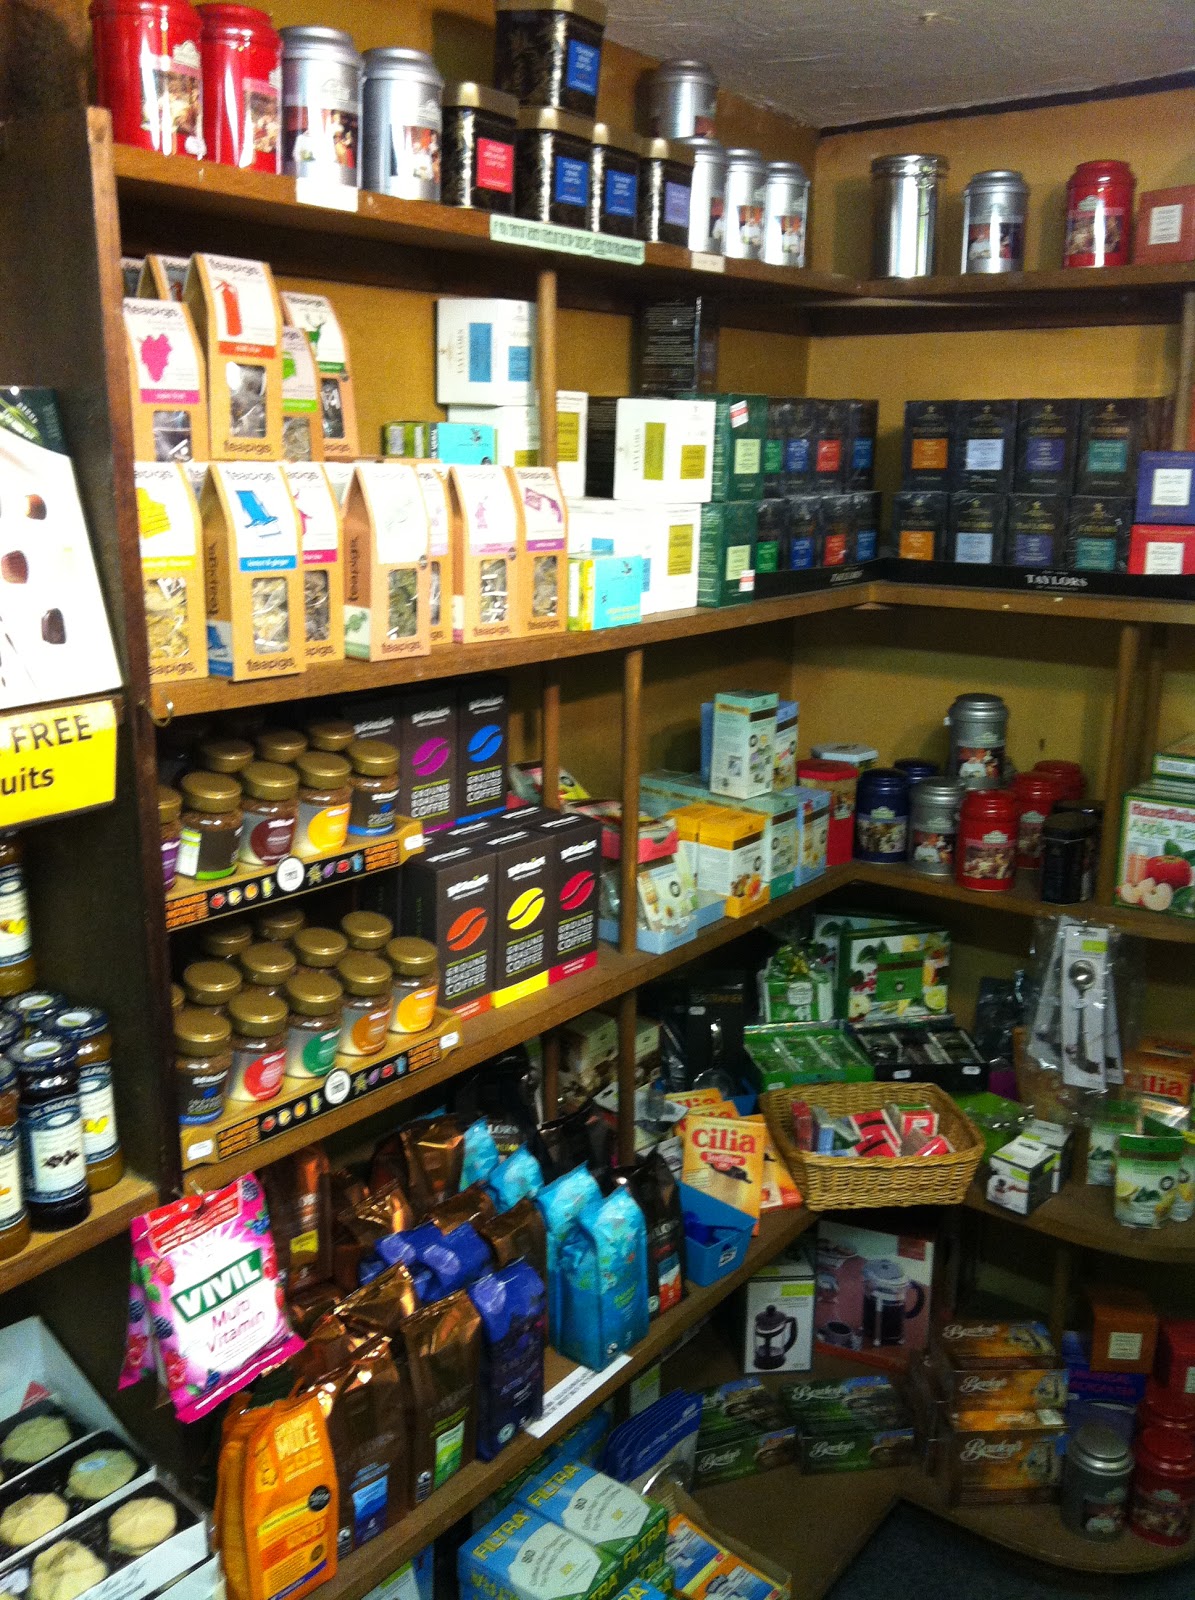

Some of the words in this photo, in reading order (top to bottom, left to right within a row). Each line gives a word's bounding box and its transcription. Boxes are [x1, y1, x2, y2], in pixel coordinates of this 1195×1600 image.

[1024, 574, 1089, 588] TAYLORS
[149, 661, 197, 676] eapigs
[246, 657, 296, 673] teapigs
[9, 714, 93, 754] FREE
[1, 766, 54, 797] uits
[466, 785, 502, 802] COFFEE
[411, 799, 450, 818] COFFEE
[557, 915, 594, 934] GROUND
[506, 934, 545, 955] GROUND
[557, 932, 593, 951] COFFEE
[445, 955, 487, 977] GROUND
[505, 952, 543, 974] COFFEE
[445, 973, 486, 996] COFFEE
[175, 1266, 260, 1318] VIVIL
[206, 1309, 267, 1352] Vitamin
[526, 1463, 582, 1508] FILTRA
[472, 1509, 533, 1562] FILTRA
